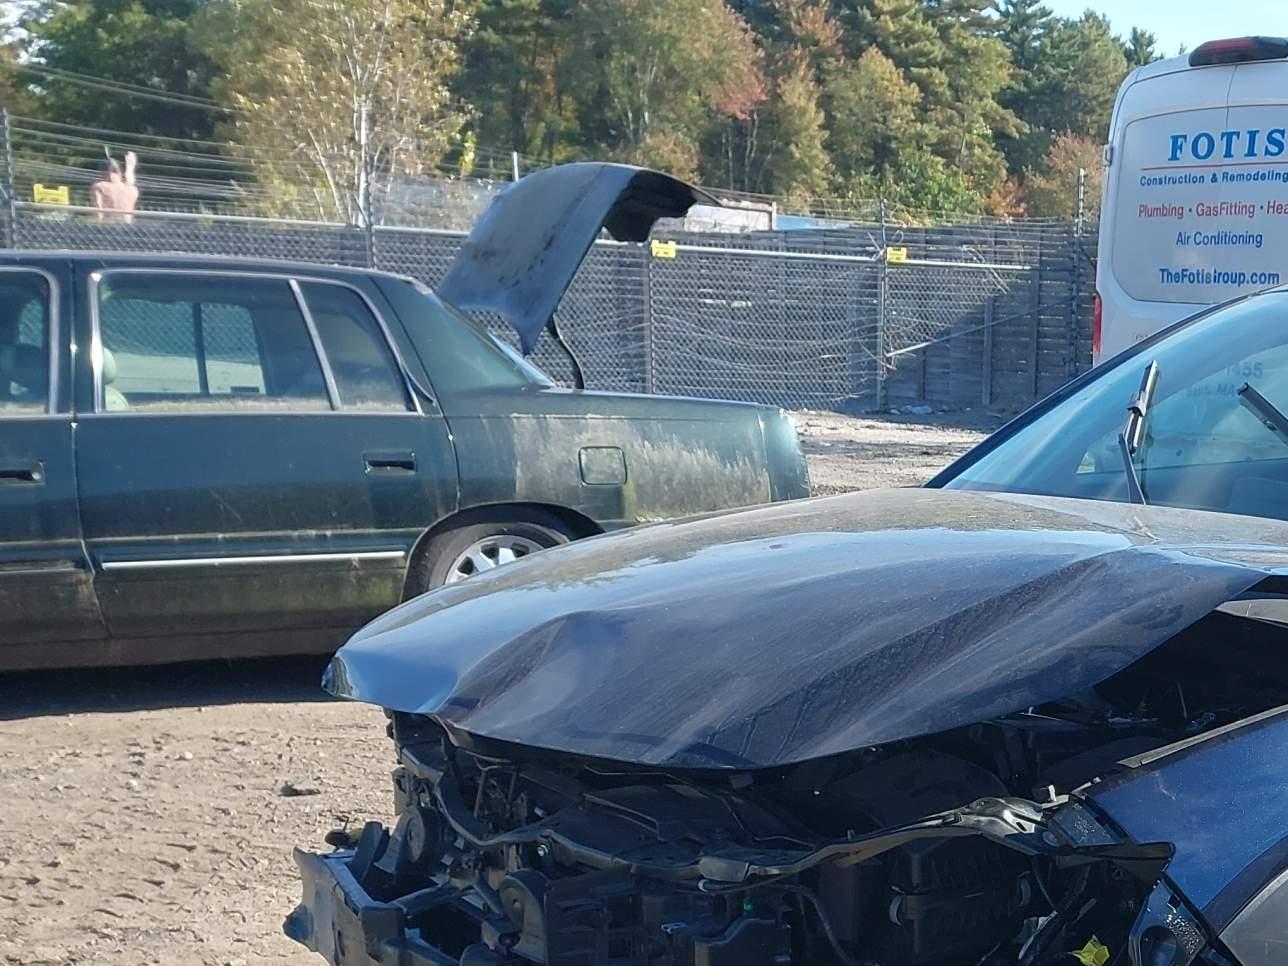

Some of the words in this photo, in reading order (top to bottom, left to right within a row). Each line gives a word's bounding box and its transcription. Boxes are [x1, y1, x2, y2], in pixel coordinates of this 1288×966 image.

[1167, 128, 1286, 161] FOTIS
[1140, 173, 1205, 187] Construction
[1211, 172, 1218, 183] &
[1138, 203, 1185, 220] Plumbing
[1196, 201, 1256, 219] GasFitting
[1176, 231, 1191, 246] Air
